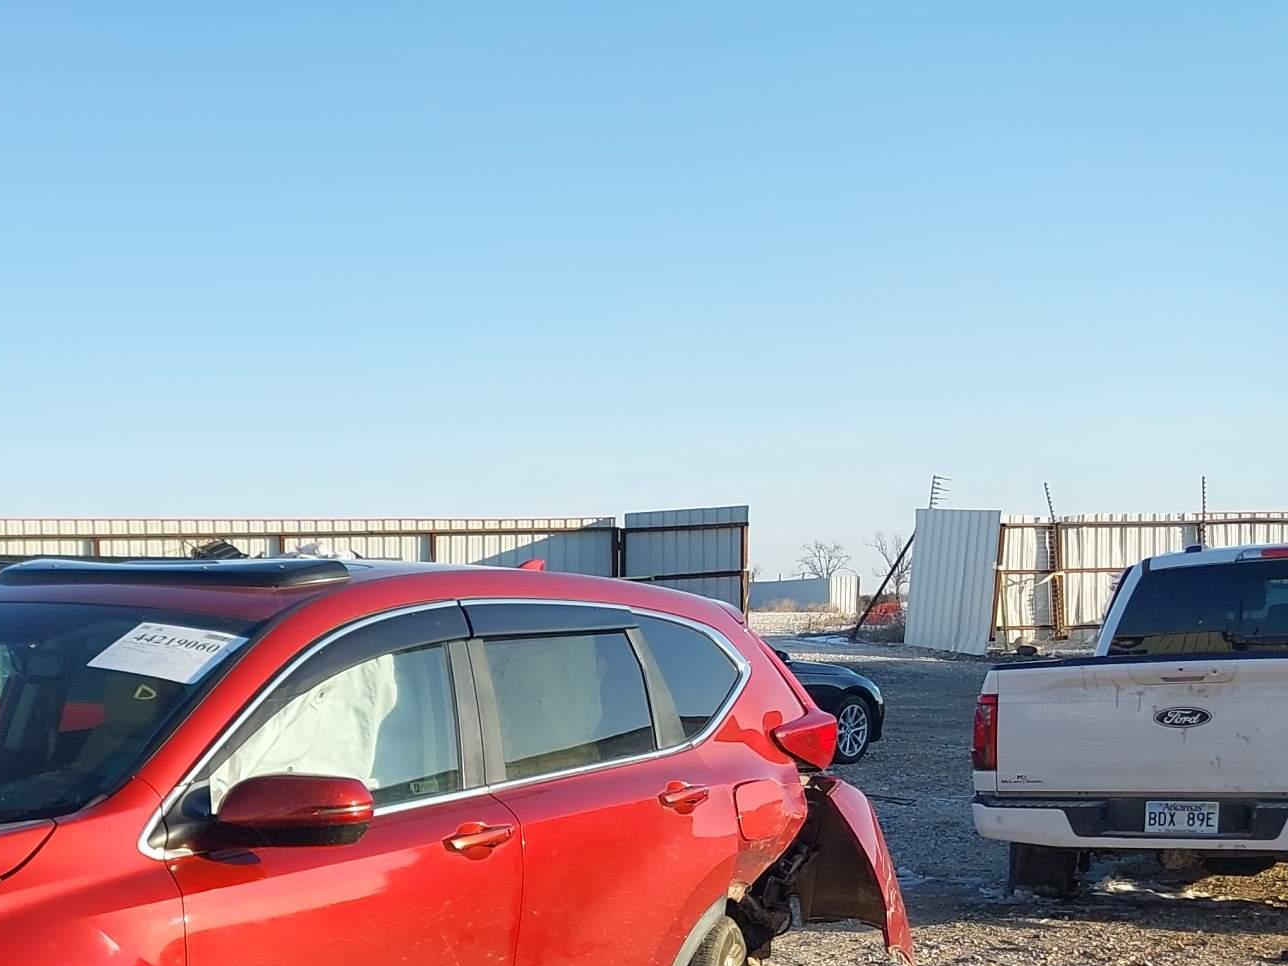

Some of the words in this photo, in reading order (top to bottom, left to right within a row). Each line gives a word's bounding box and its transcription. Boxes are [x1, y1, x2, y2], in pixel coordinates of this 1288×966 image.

[133, 633, 221, 653] 44219060
[1163, 710, 1201, 724] Ford
[1163, 803, 1202, 812] Arkansas
[1148, 811, 1176, 827] BDX
[1187, 812, 1217, 827] 89E
